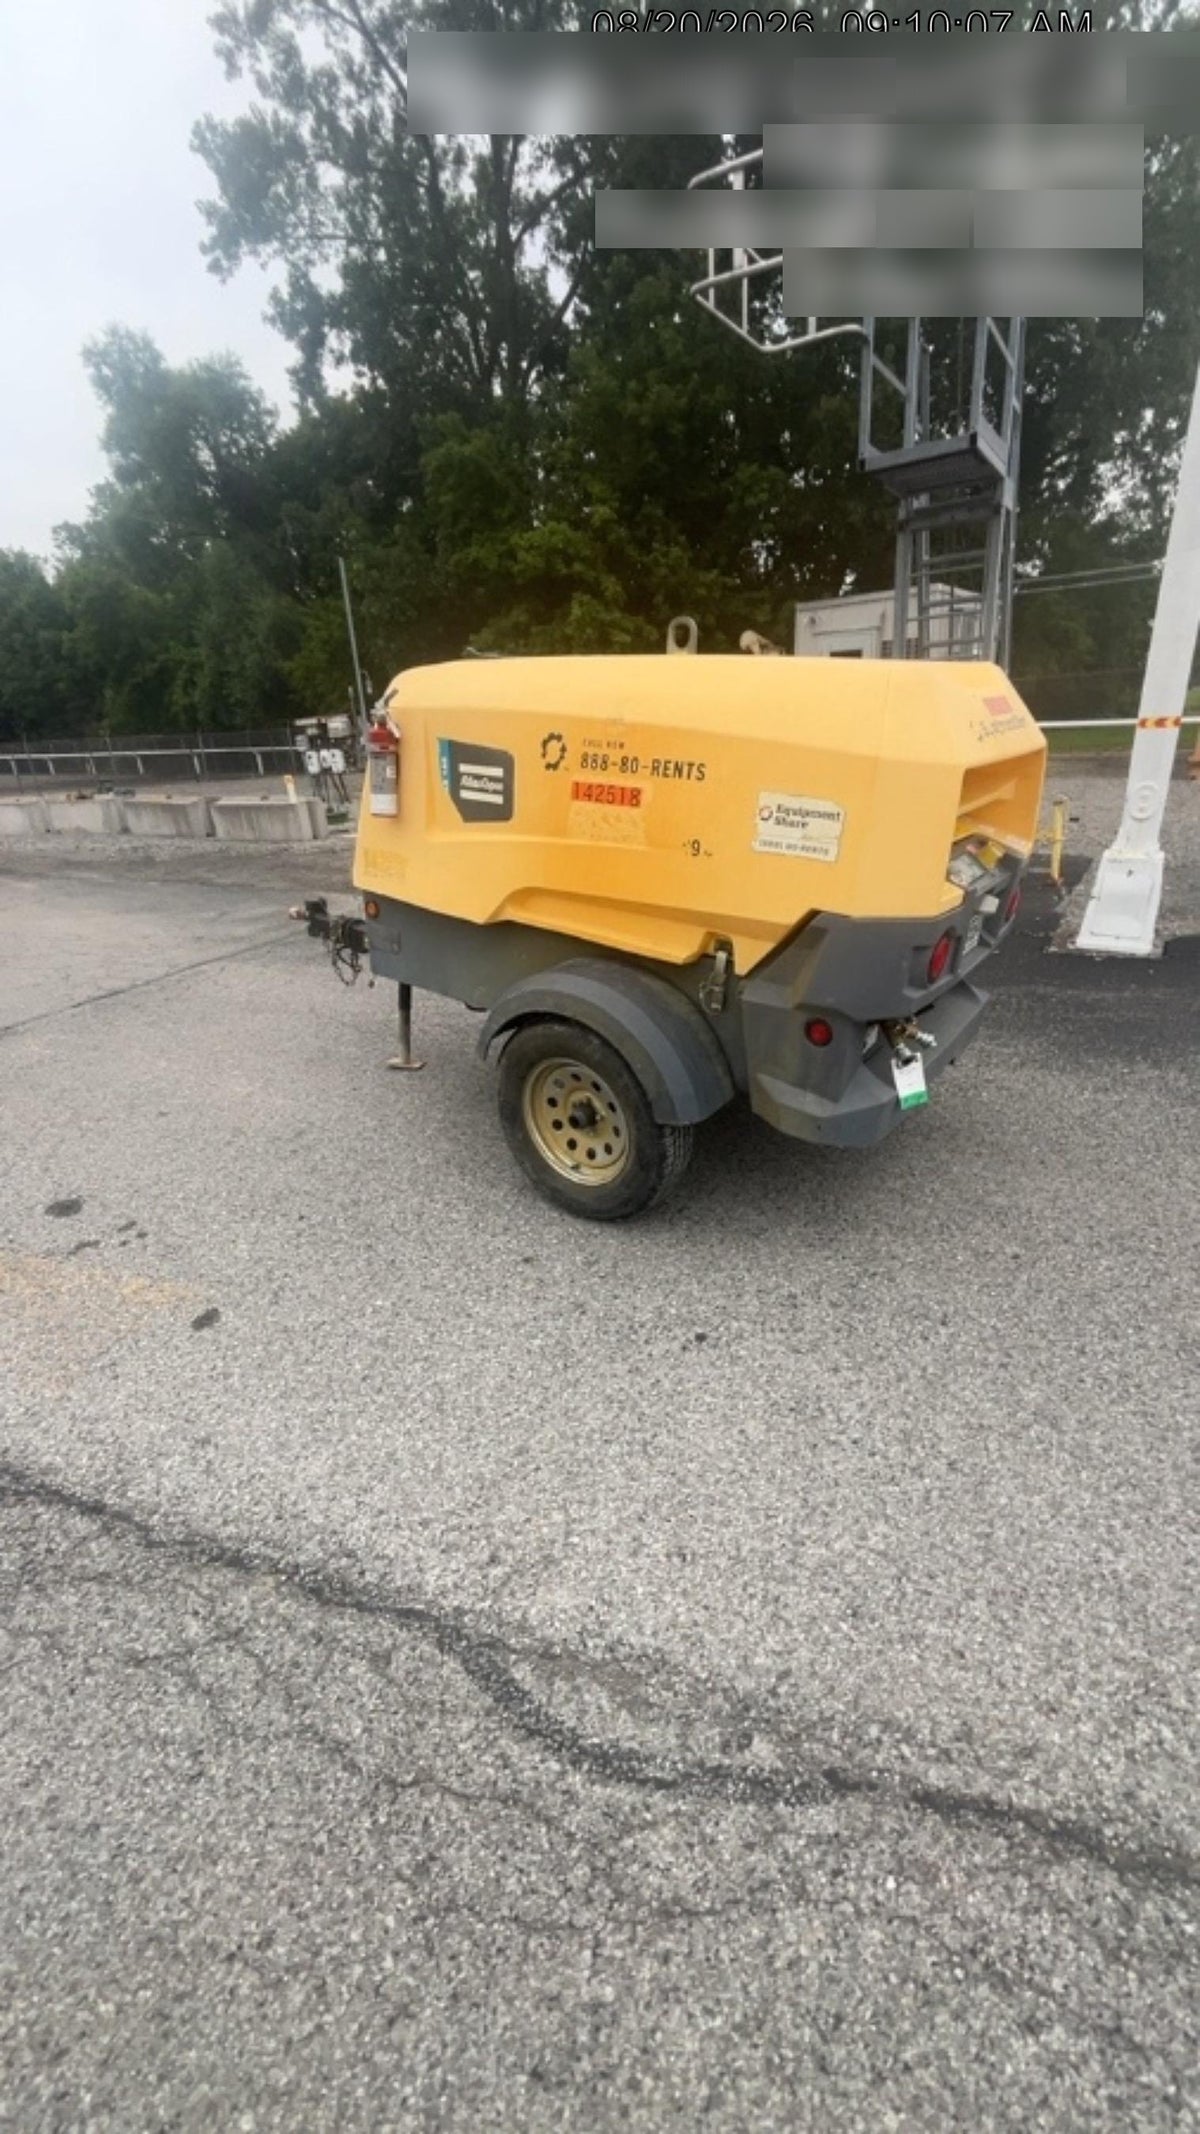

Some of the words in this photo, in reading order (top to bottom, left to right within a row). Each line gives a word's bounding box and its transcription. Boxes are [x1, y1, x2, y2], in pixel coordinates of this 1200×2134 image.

[580, 752, 707, 781] 888-80-RENTS
[573, 782, 642, 808] 142518
[774, 816, 808, 829] Share
[775, 804, 841, 822] Equipment
